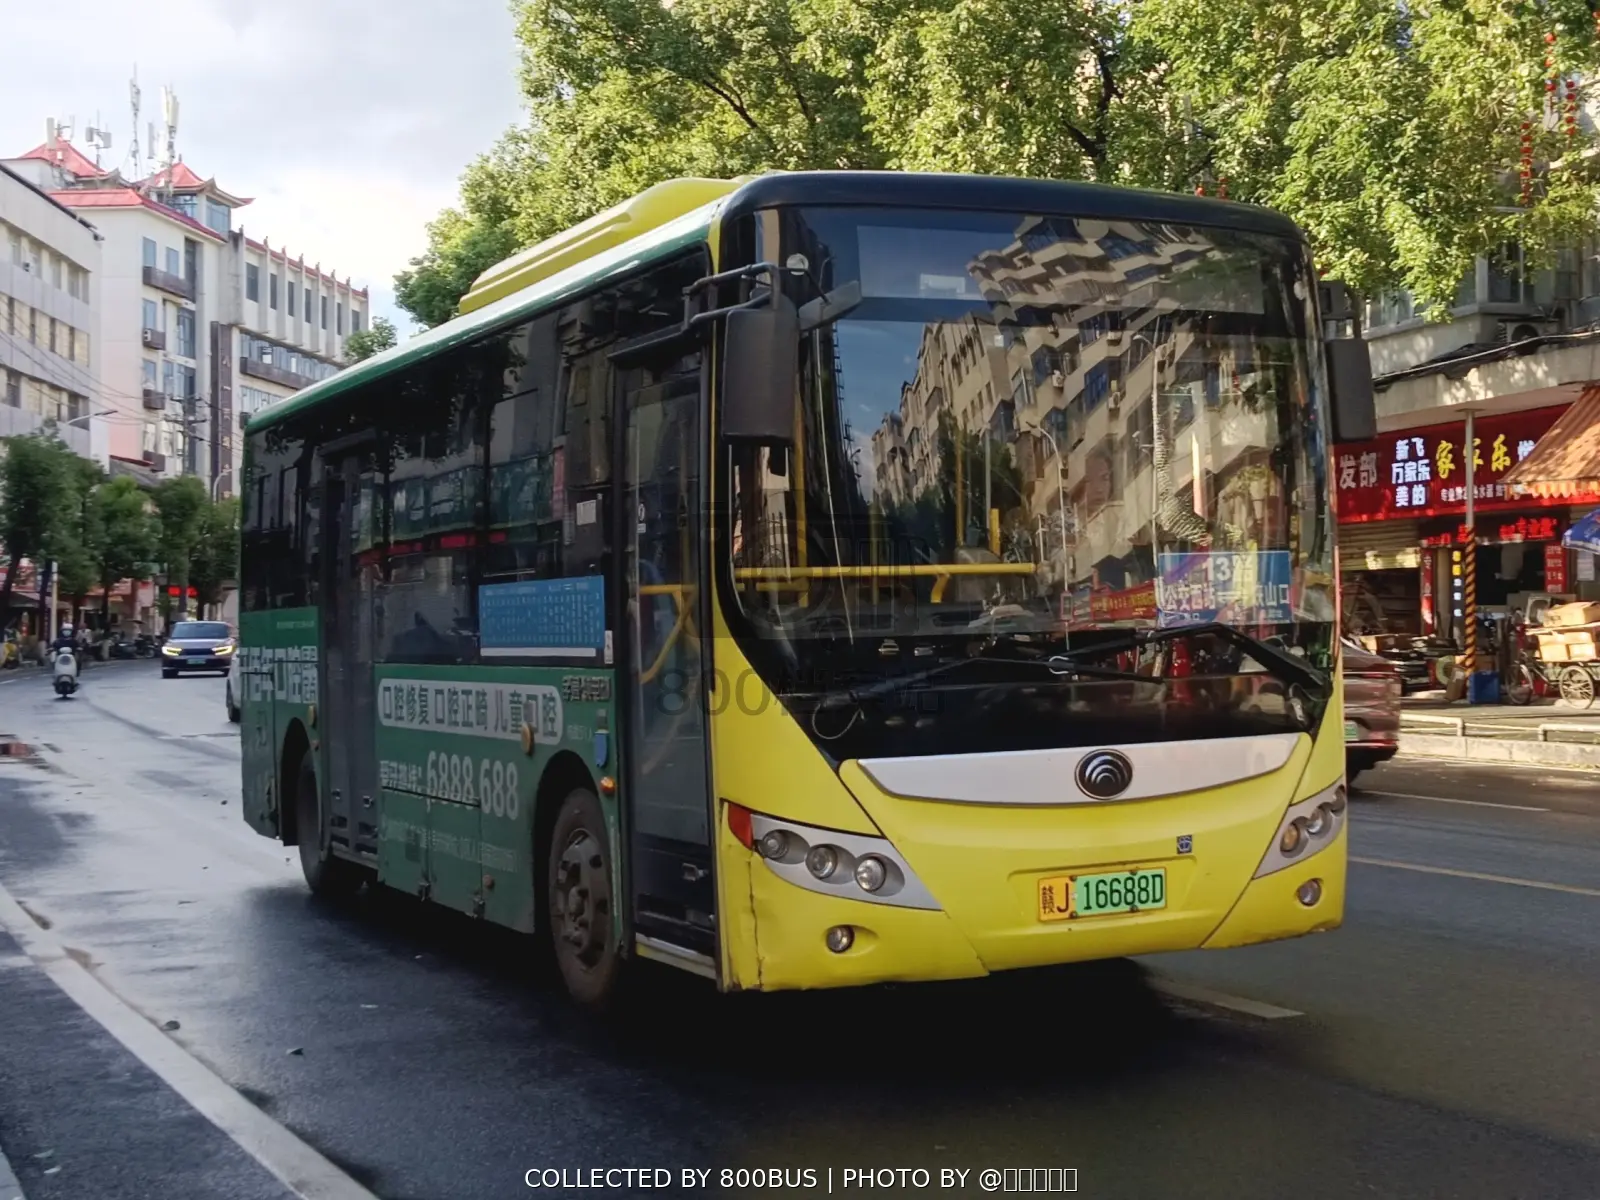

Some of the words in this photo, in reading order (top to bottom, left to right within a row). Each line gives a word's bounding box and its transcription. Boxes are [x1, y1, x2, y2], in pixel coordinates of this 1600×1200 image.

[1395, 436, 1426, 461] 新飞
[1391, 459, 1432, 485] 万家乐
[1395, 484, 1427, 507] 美的
[382, 684, 430, 726] 口腔修复
[434, 686, 489, 731] 口腔正畸
[494, 689, 559, 738] 儿童口腔
[1083, 873, 1164, 911] 16688D
